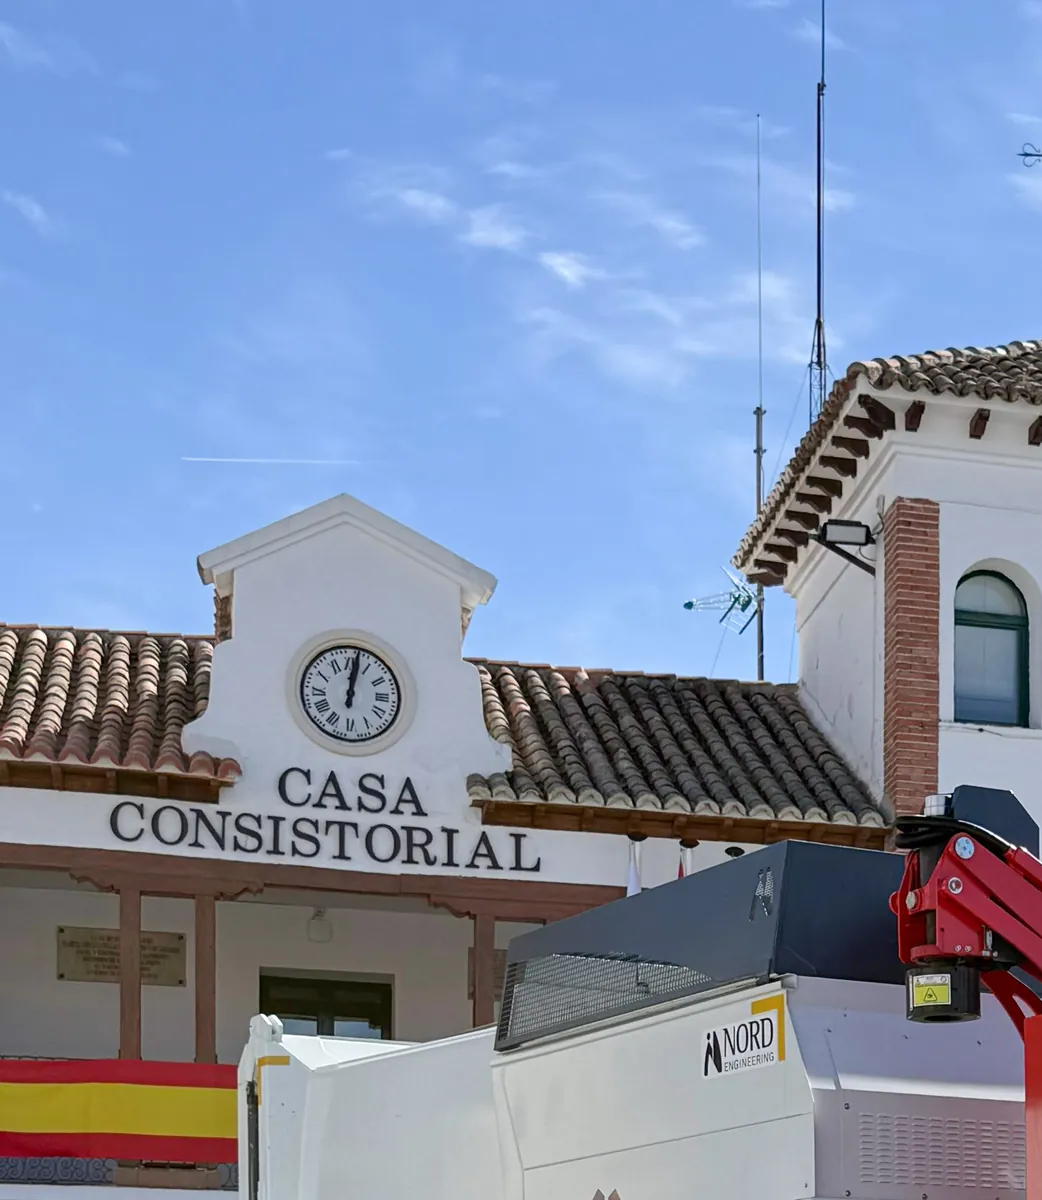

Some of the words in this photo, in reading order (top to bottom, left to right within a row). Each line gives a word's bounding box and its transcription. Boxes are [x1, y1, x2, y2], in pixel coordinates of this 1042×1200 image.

[278, 767, 428, 816] CASA
[109, 801, 541, 872] CONSISTORIAL
[722, 1017, 774, 1058] NORD
[723, 1051, 775, 1073] ENGINEERING
